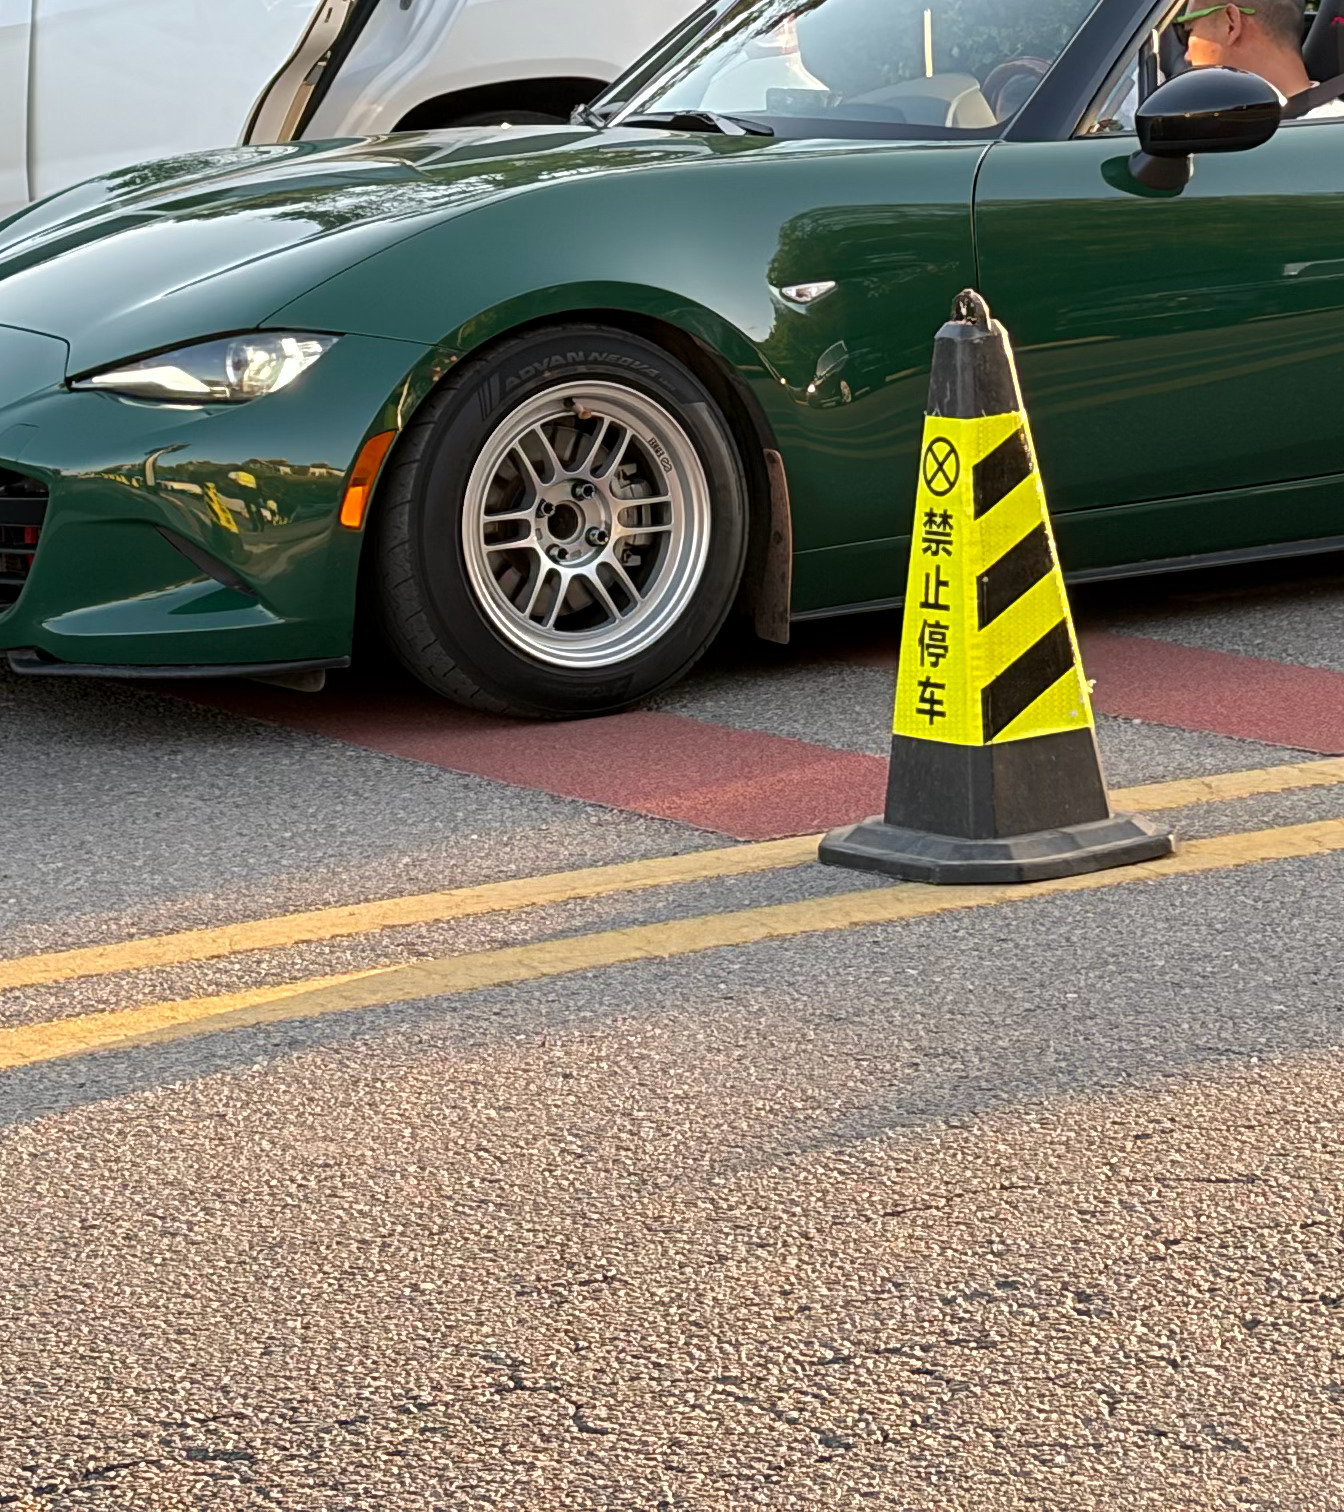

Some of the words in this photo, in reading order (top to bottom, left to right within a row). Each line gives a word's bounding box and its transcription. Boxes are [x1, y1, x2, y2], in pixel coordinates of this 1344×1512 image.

[506, 351, 585, 386] ADVAN
[587, 351, 660, 380] NEOVA
[915, 507, 954, 726] 禁止停车
